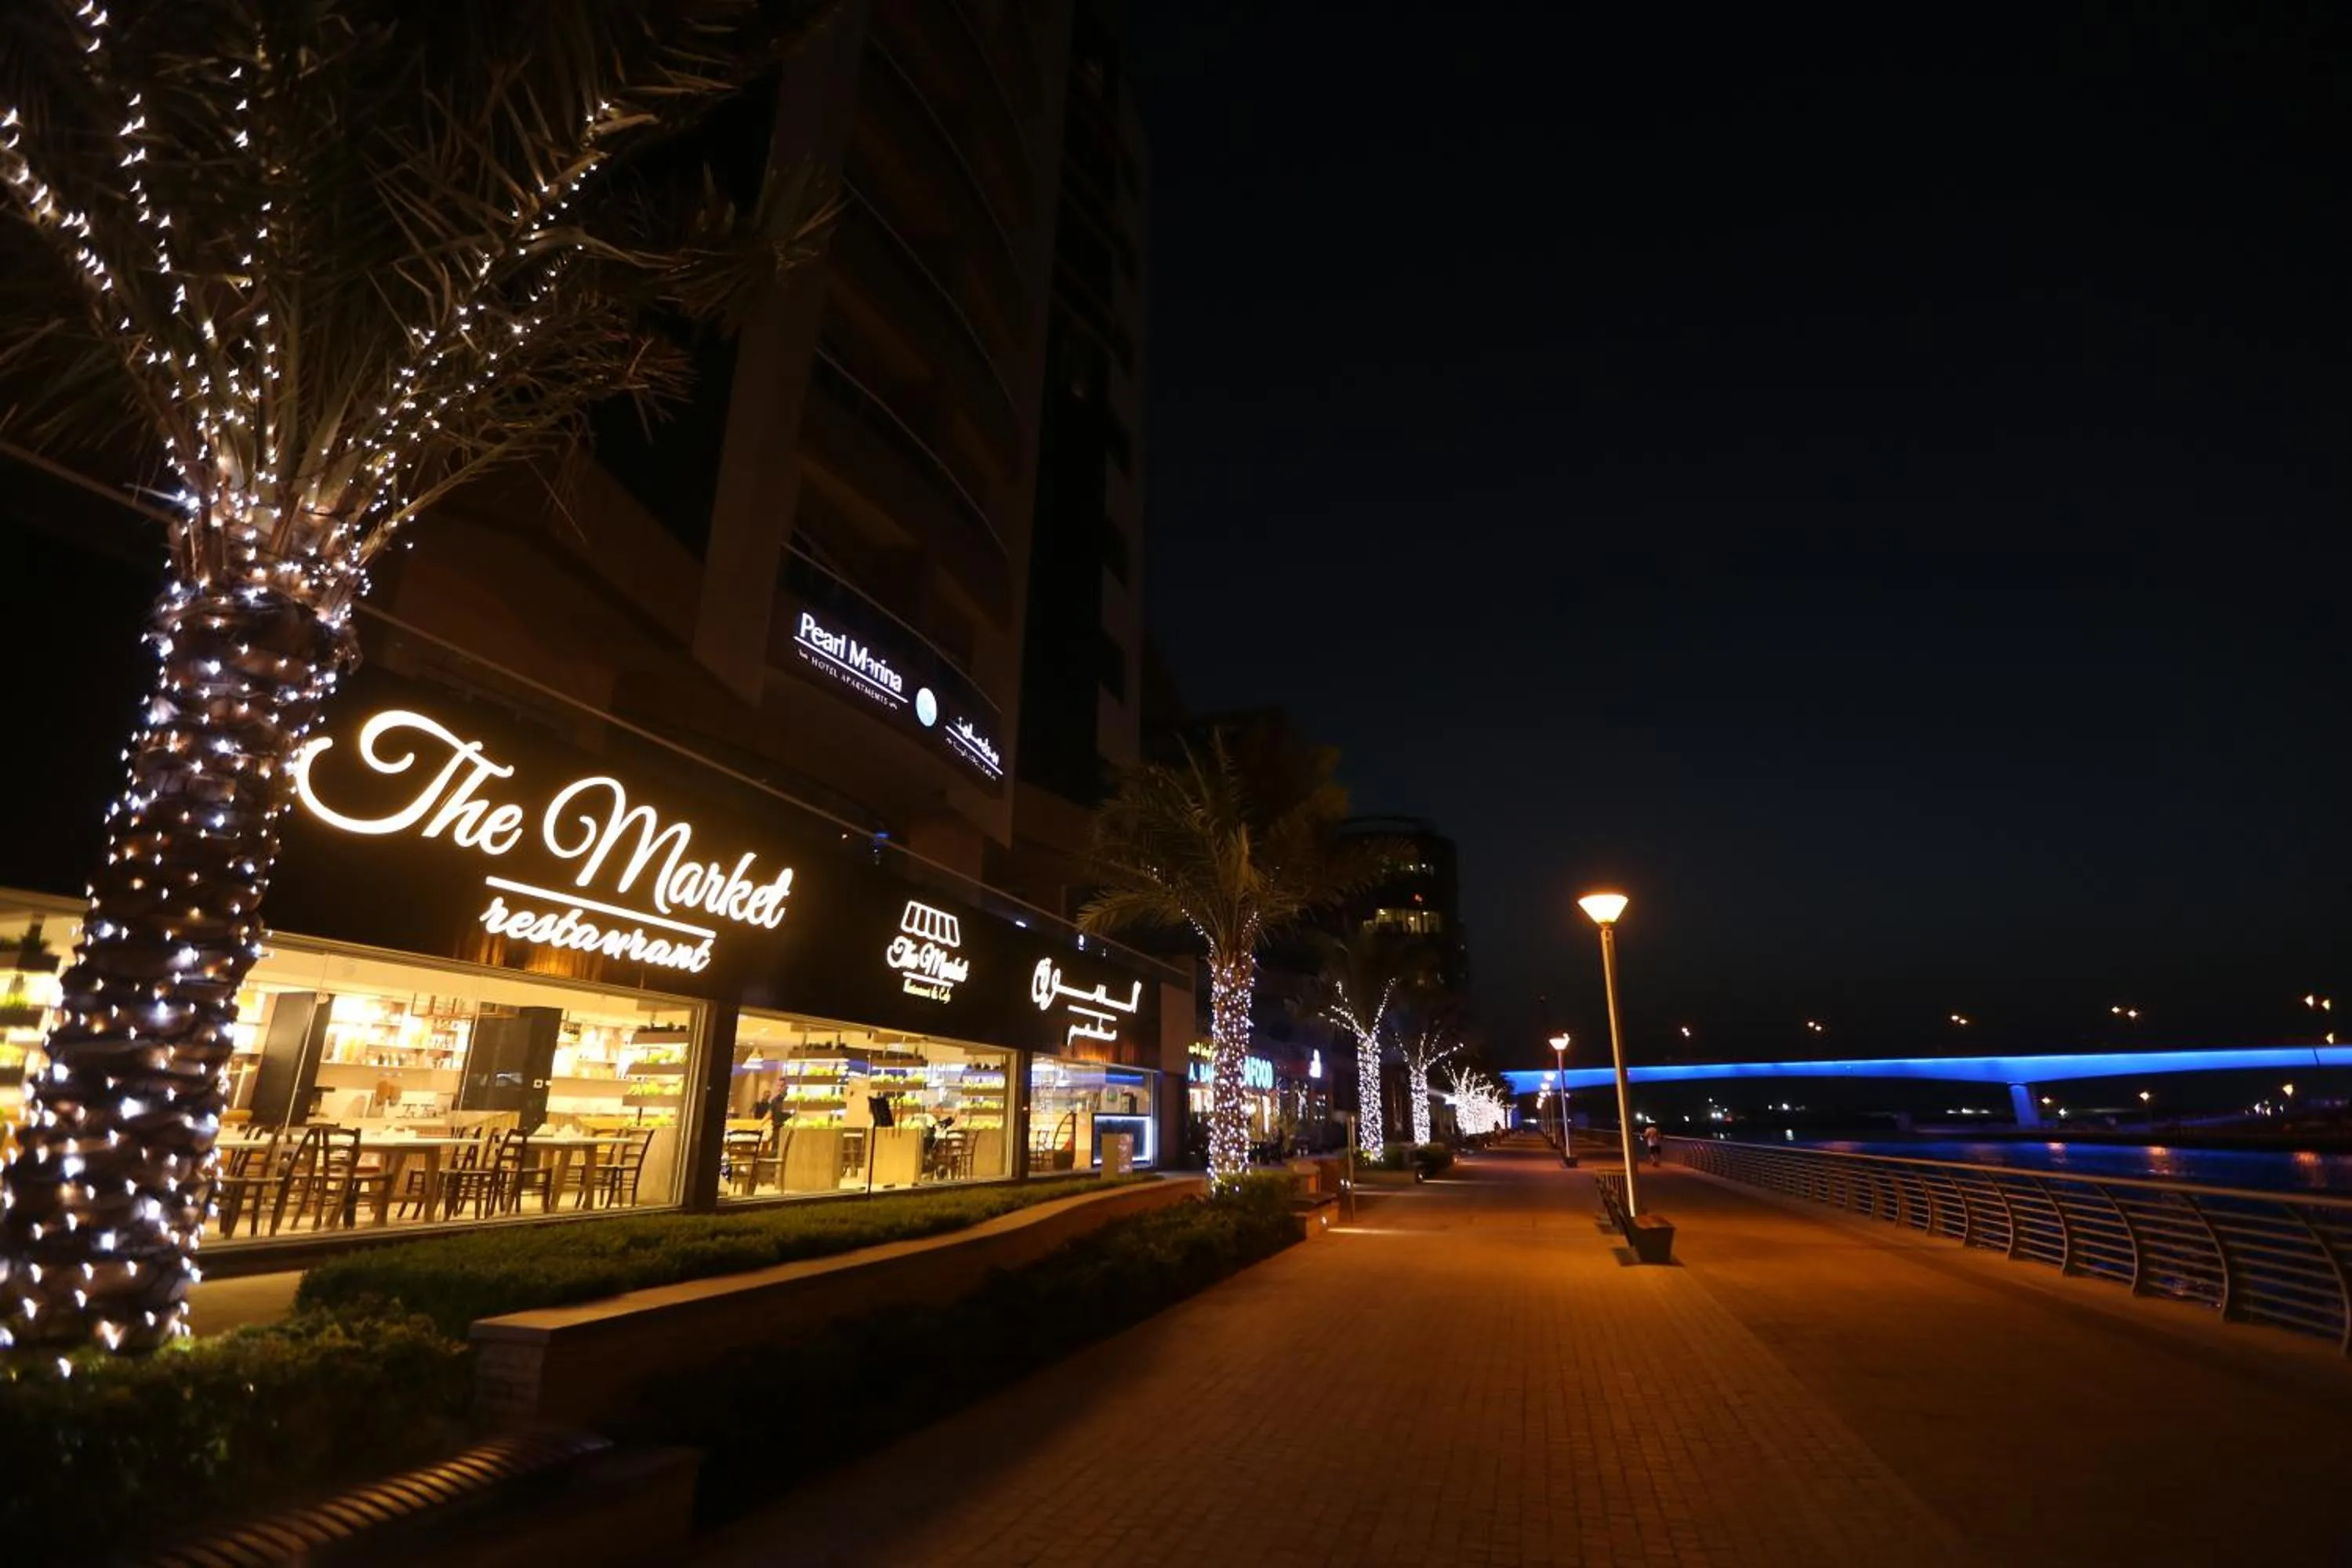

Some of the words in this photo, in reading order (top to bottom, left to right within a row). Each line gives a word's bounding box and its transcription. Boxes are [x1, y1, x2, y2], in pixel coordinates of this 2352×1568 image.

[800, 612, 846, 659] Pearl
[848, 639, 902, 693] Marina
[811, 656, 838, 678] HOTEL
[840, 674, 889, 706] APARTMENTS
[294, 710, 524, 855] The
[543, 775, 794, 929] Market
[478, 896, 716, 974] restaurant
[1067, 1017, 1117, 1047] مطعم
